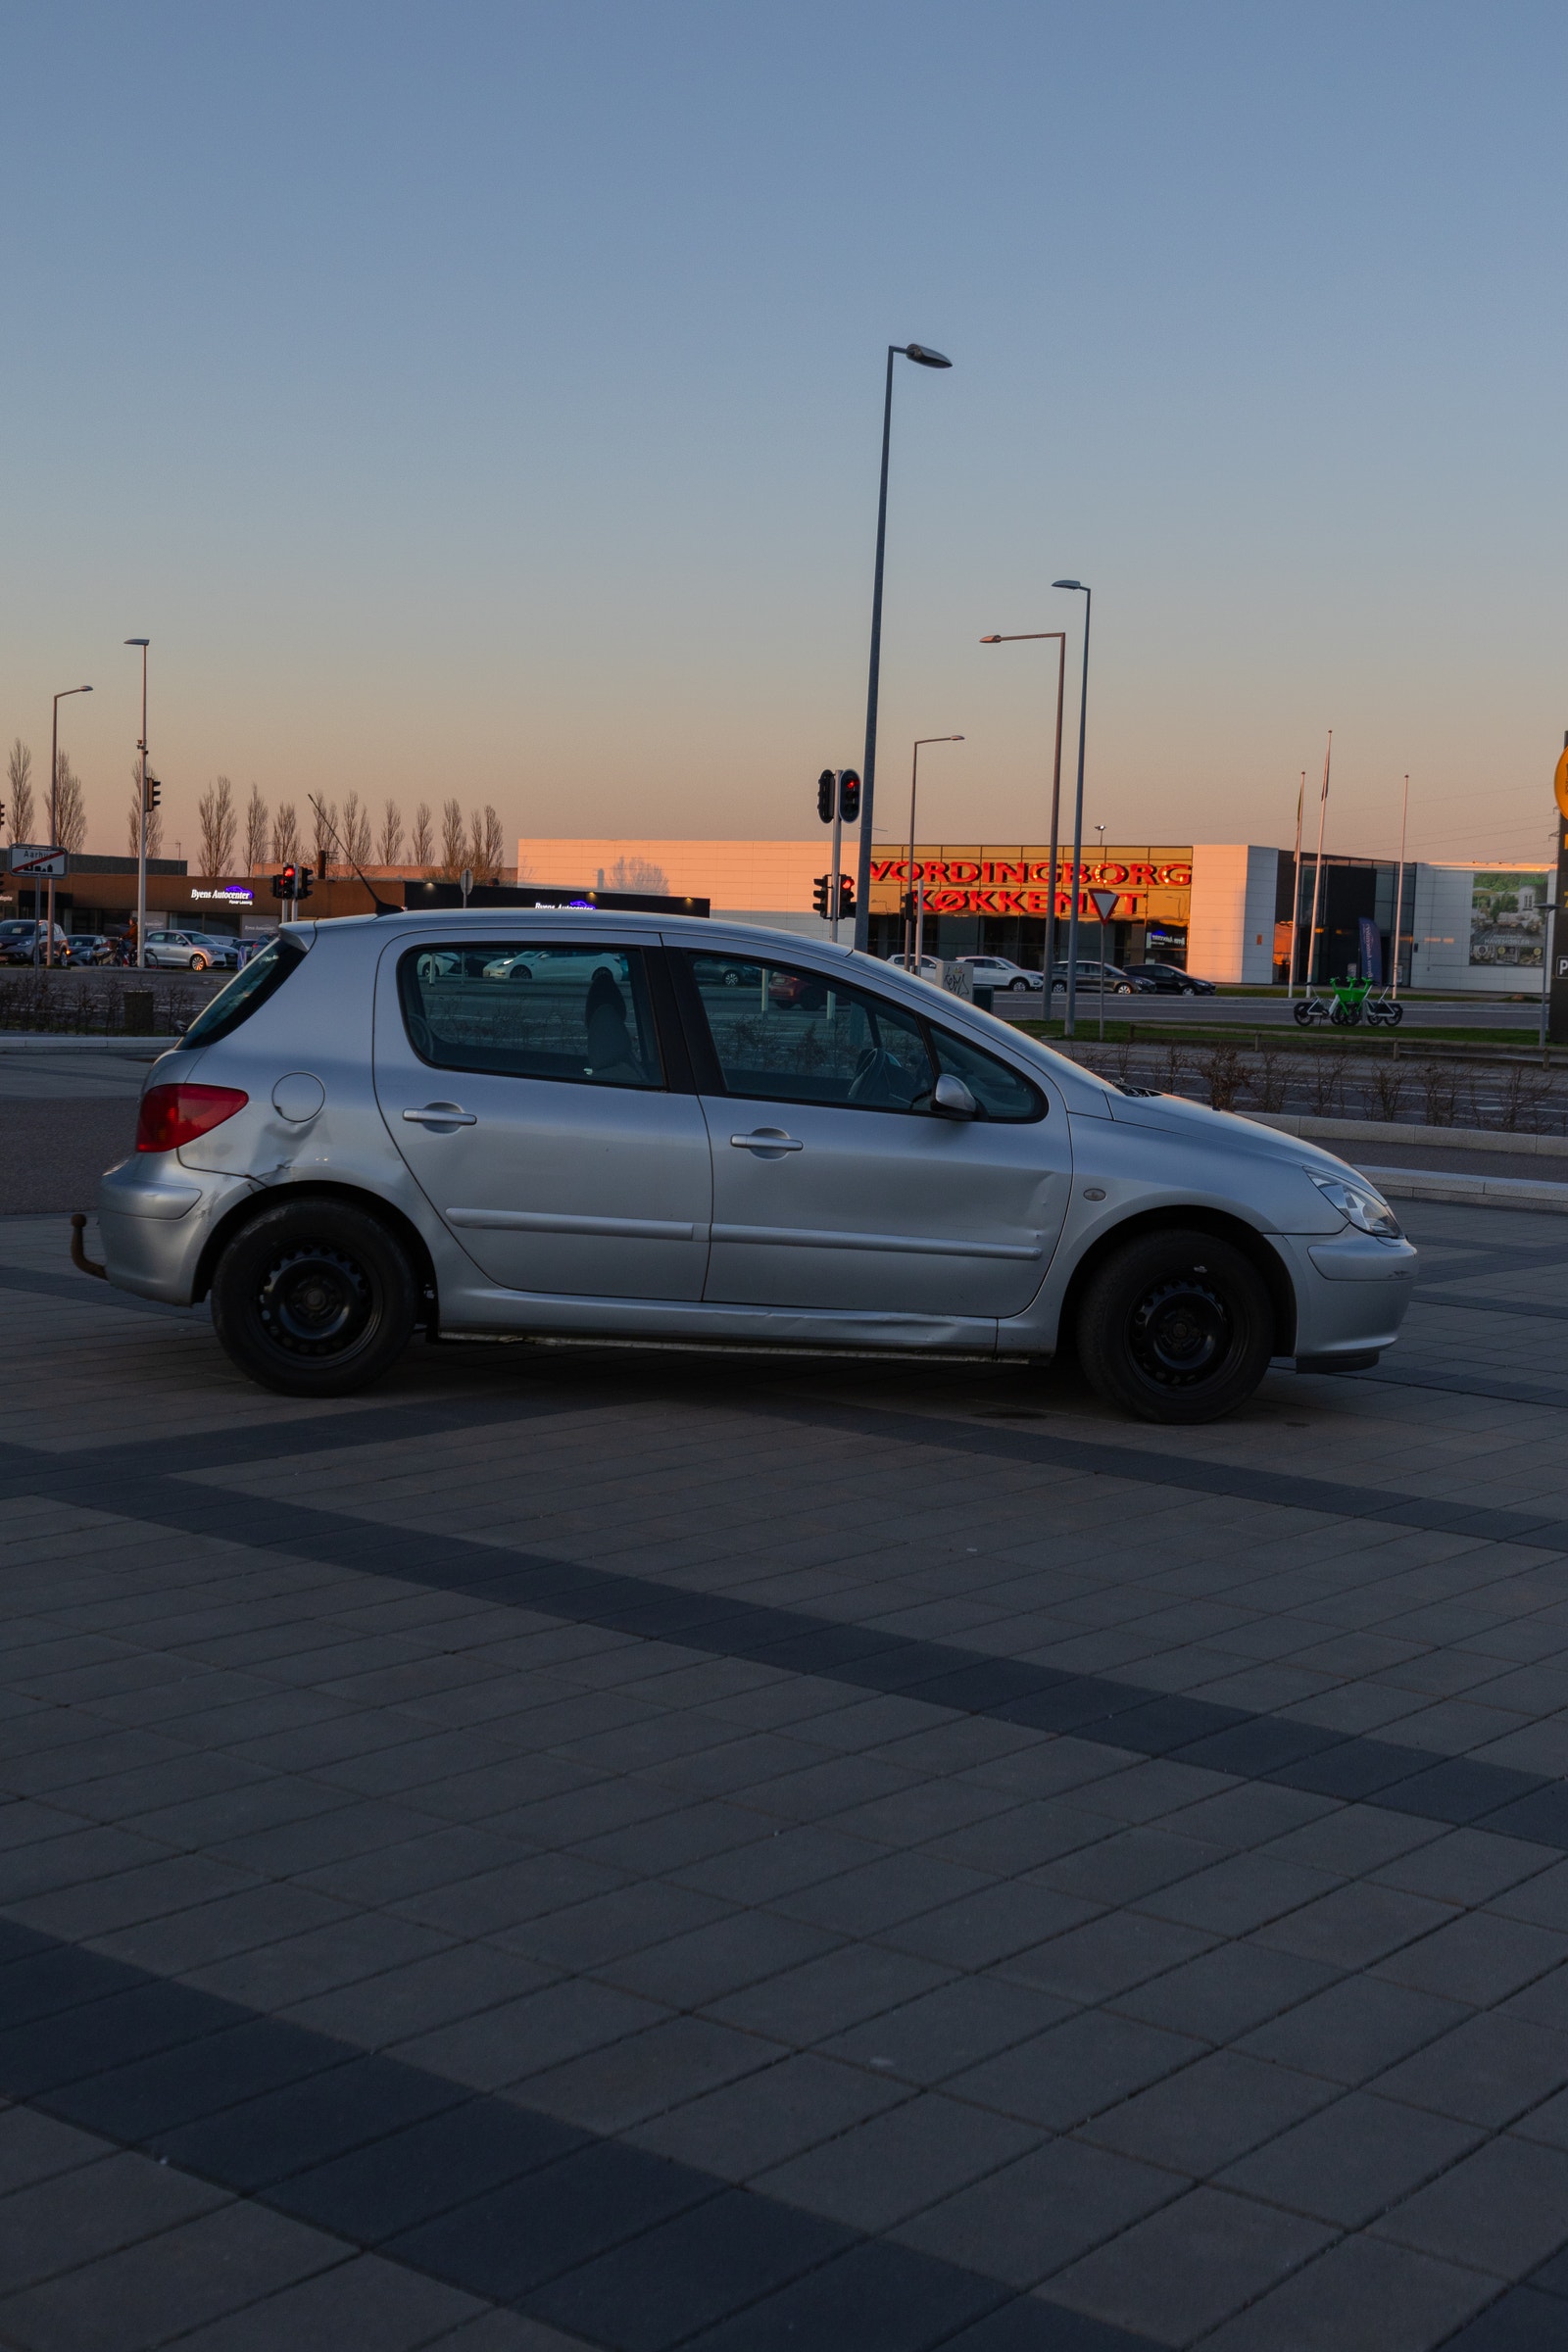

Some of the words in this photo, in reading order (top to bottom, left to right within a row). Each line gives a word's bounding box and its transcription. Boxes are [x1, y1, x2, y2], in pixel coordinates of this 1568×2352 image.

[870, 860, 1192, 886] VORDINGBORG
[191, 889, 212, 900] Byens
[212, 890, 250, 899] Autocenter
[911, 889, 1146, 915] KØKKENT
